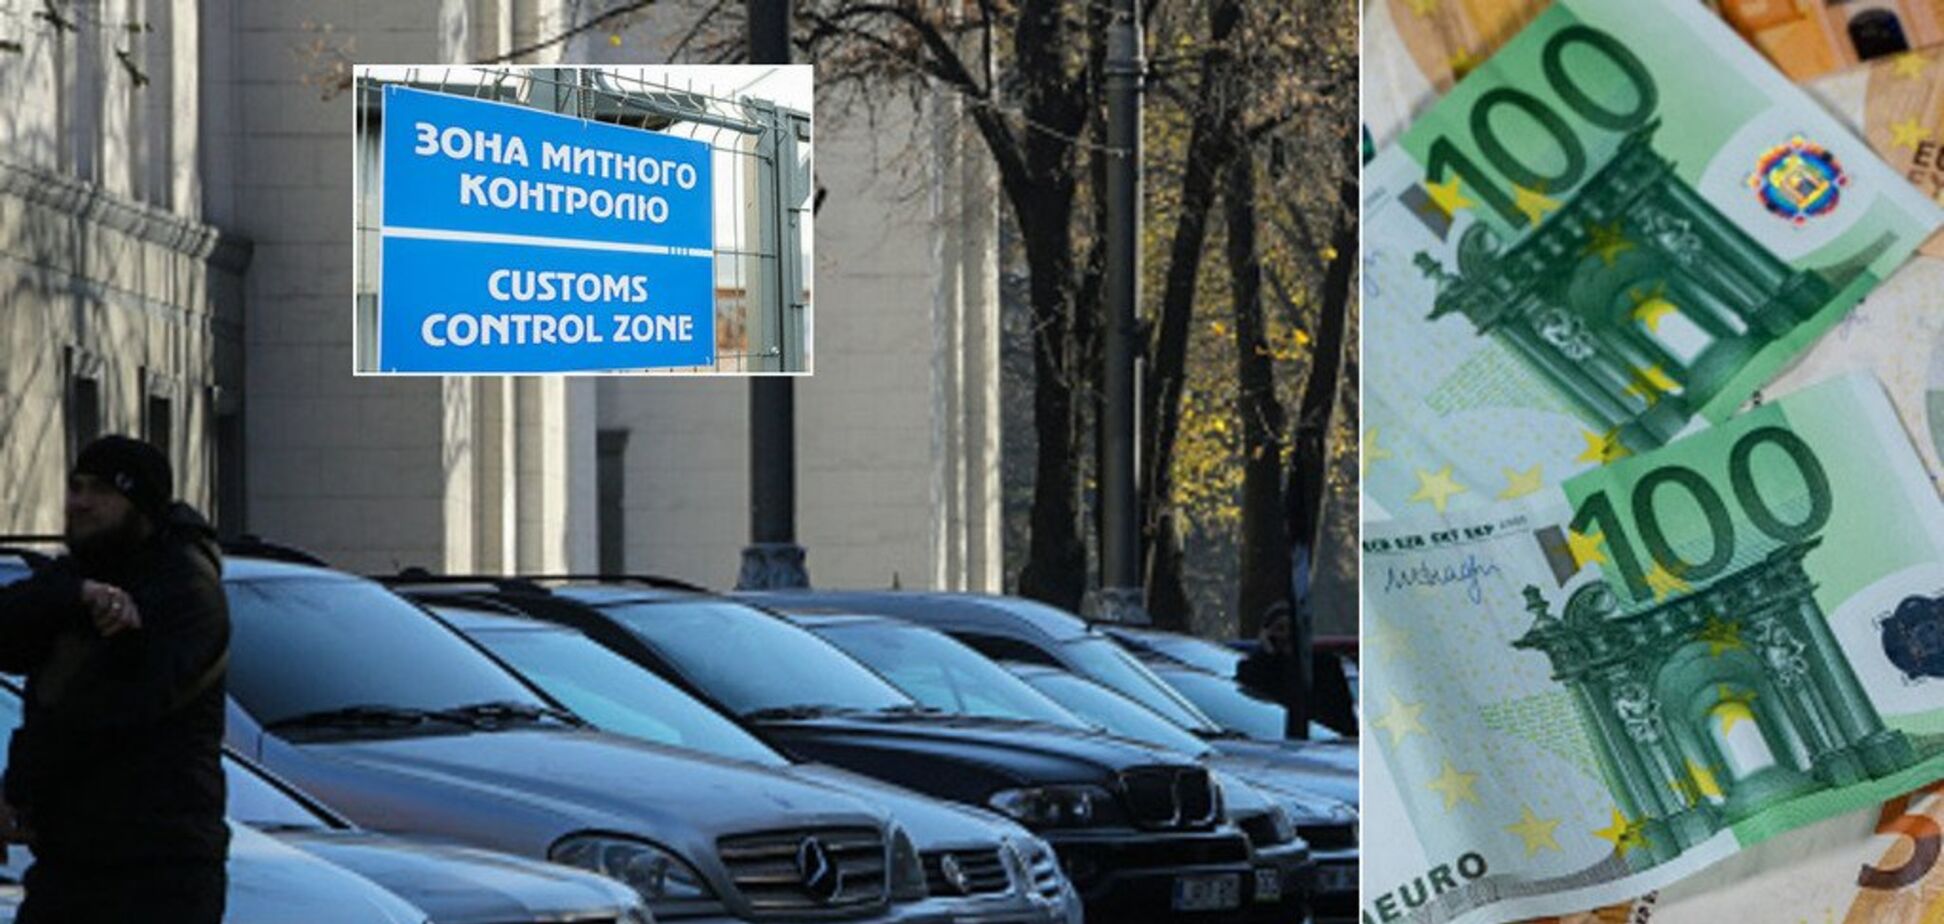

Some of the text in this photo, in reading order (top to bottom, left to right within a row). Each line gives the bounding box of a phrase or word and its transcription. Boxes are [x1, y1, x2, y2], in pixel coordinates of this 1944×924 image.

[414, 122, 697, 190] ЗОНА МИТНОГО
[1426, 25, 1658, 229] 100
[460, 172, 669, 225] КОНТРОЛЮ
[487, 269, 649, 303] CUSTOMS
[421, 313, 693, 347] CONTROL ZONE
[1569, 426, 1832, 602] 100
[1373, 852, 1488, 923] EURO
